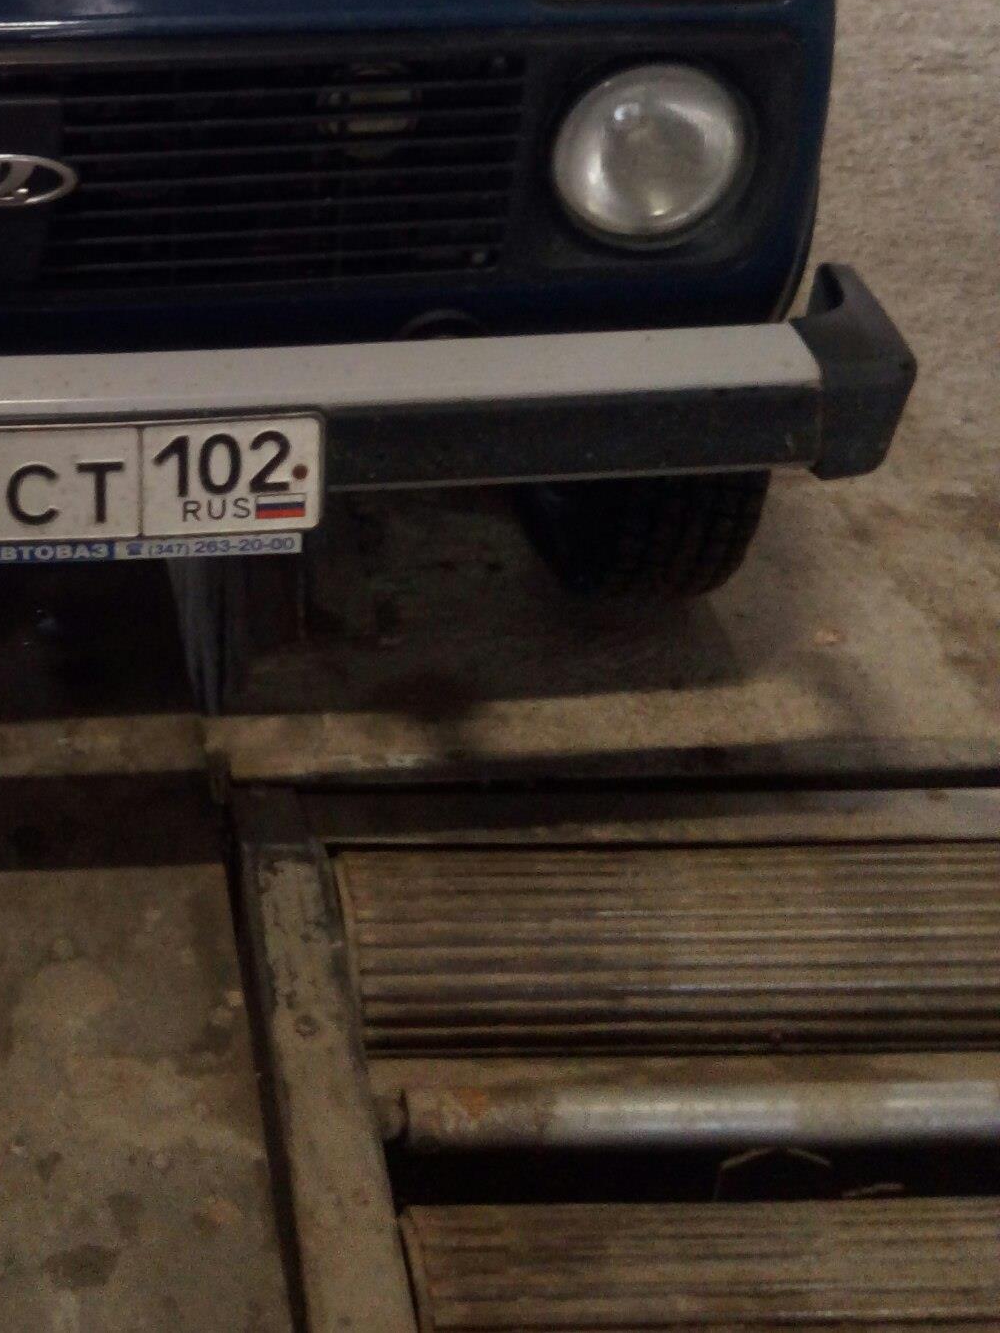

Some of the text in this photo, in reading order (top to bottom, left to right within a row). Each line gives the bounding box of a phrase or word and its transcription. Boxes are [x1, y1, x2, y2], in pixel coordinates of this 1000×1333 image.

[152, 430, 292, 499] 102
[184, 498, 251, 521] RUS
[149, 542, 190, 557] (347)
